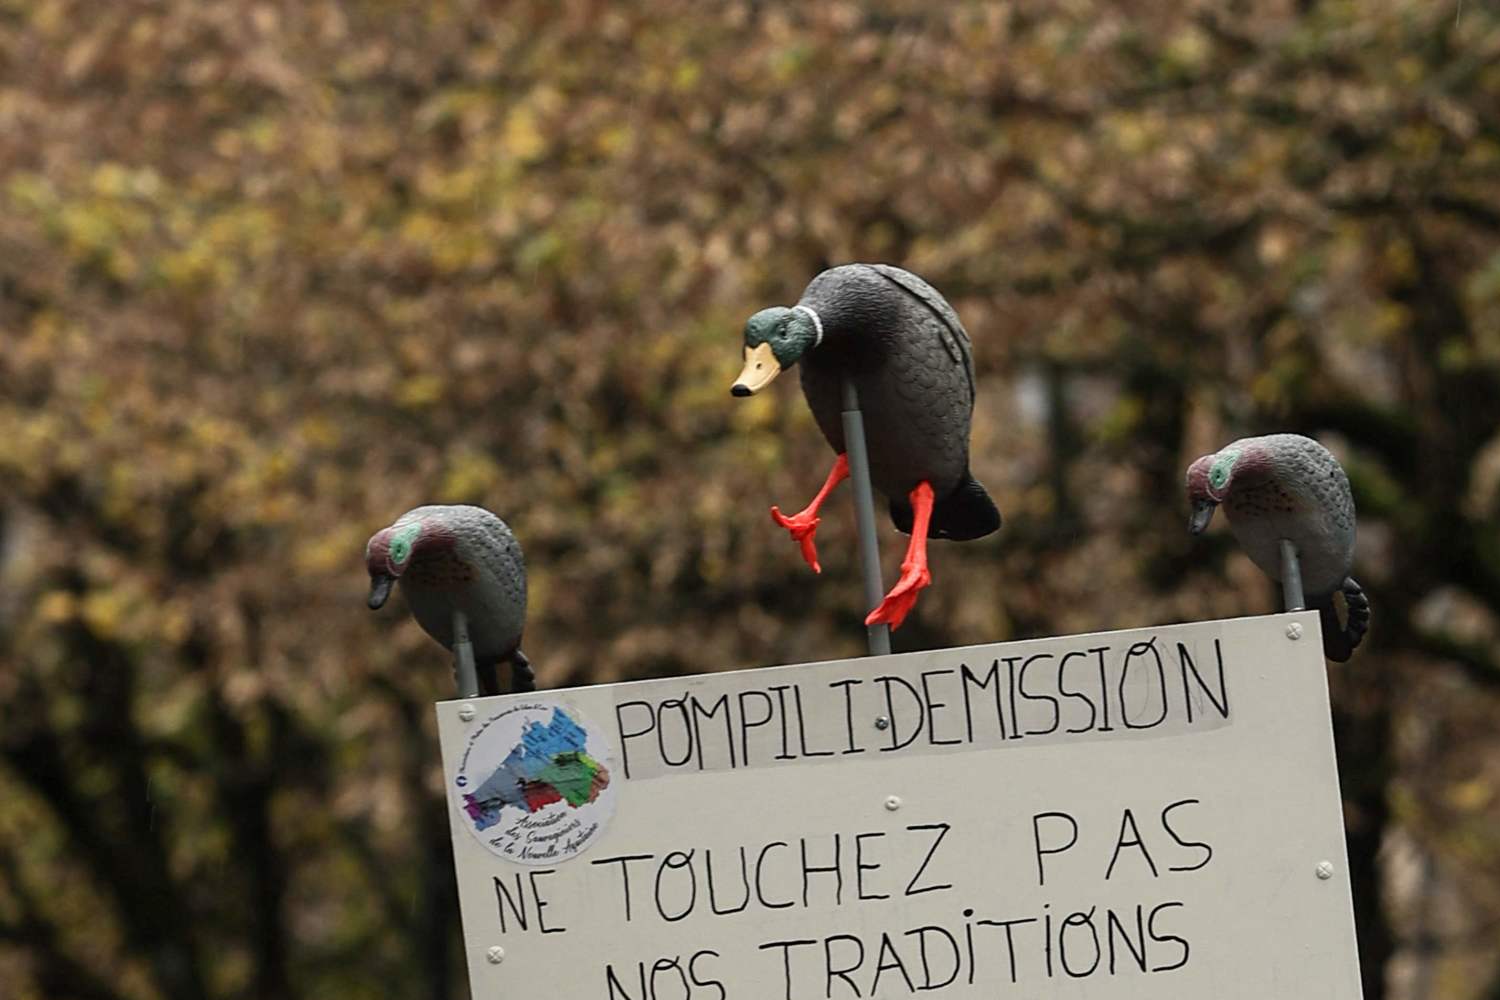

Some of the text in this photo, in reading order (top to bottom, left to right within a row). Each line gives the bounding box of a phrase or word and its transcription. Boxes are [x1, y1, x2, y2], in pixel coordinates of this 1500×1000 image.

[615, 679, 867, 780] POMPILI
[872, 636, 1229, 752] DEMISSION
[492, 799, 1213, 934] NE TOUCHEZ PAS
